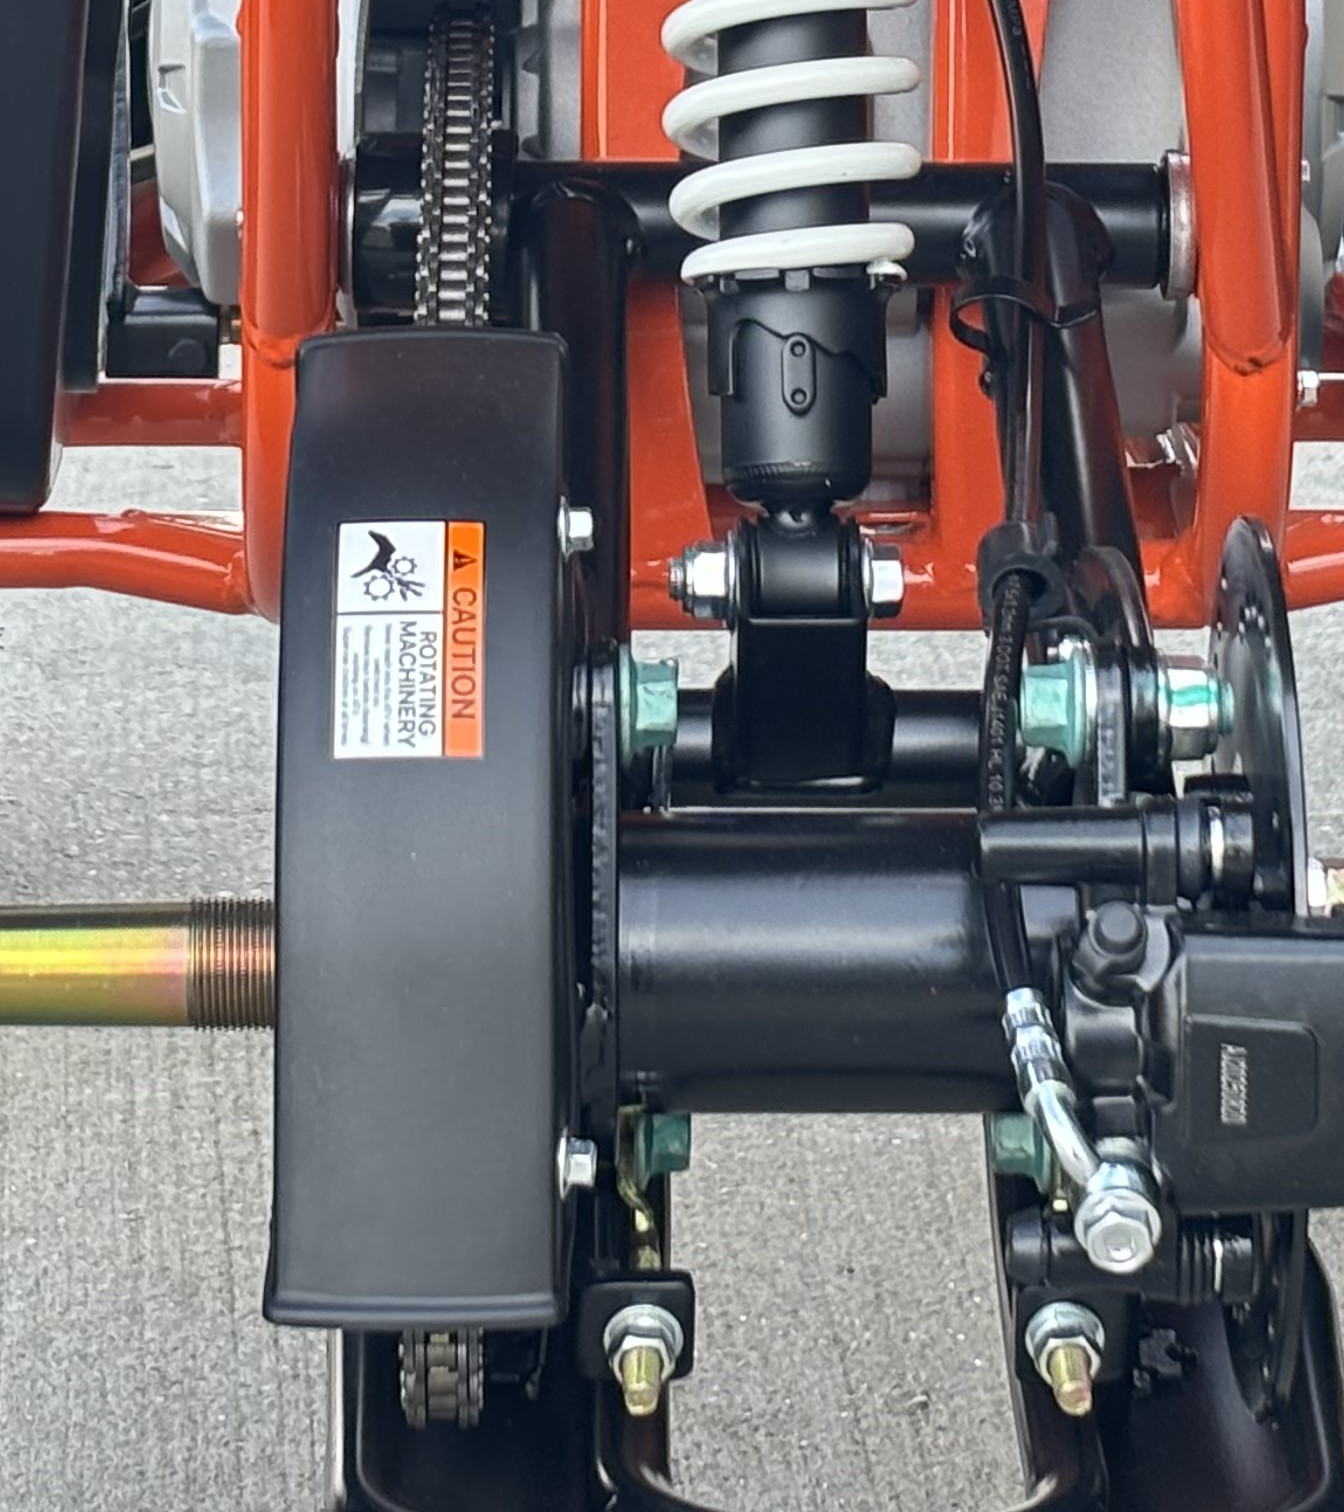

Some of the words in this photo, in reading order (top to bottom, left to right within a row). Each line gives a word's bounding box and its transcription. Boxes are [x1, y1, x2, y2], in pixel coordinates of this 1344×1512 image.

[397, 620, 417, 749] MACHINERY
[418, 631, 438, 737] ROTATING
[451, 586, 478, 720] CAUTION
